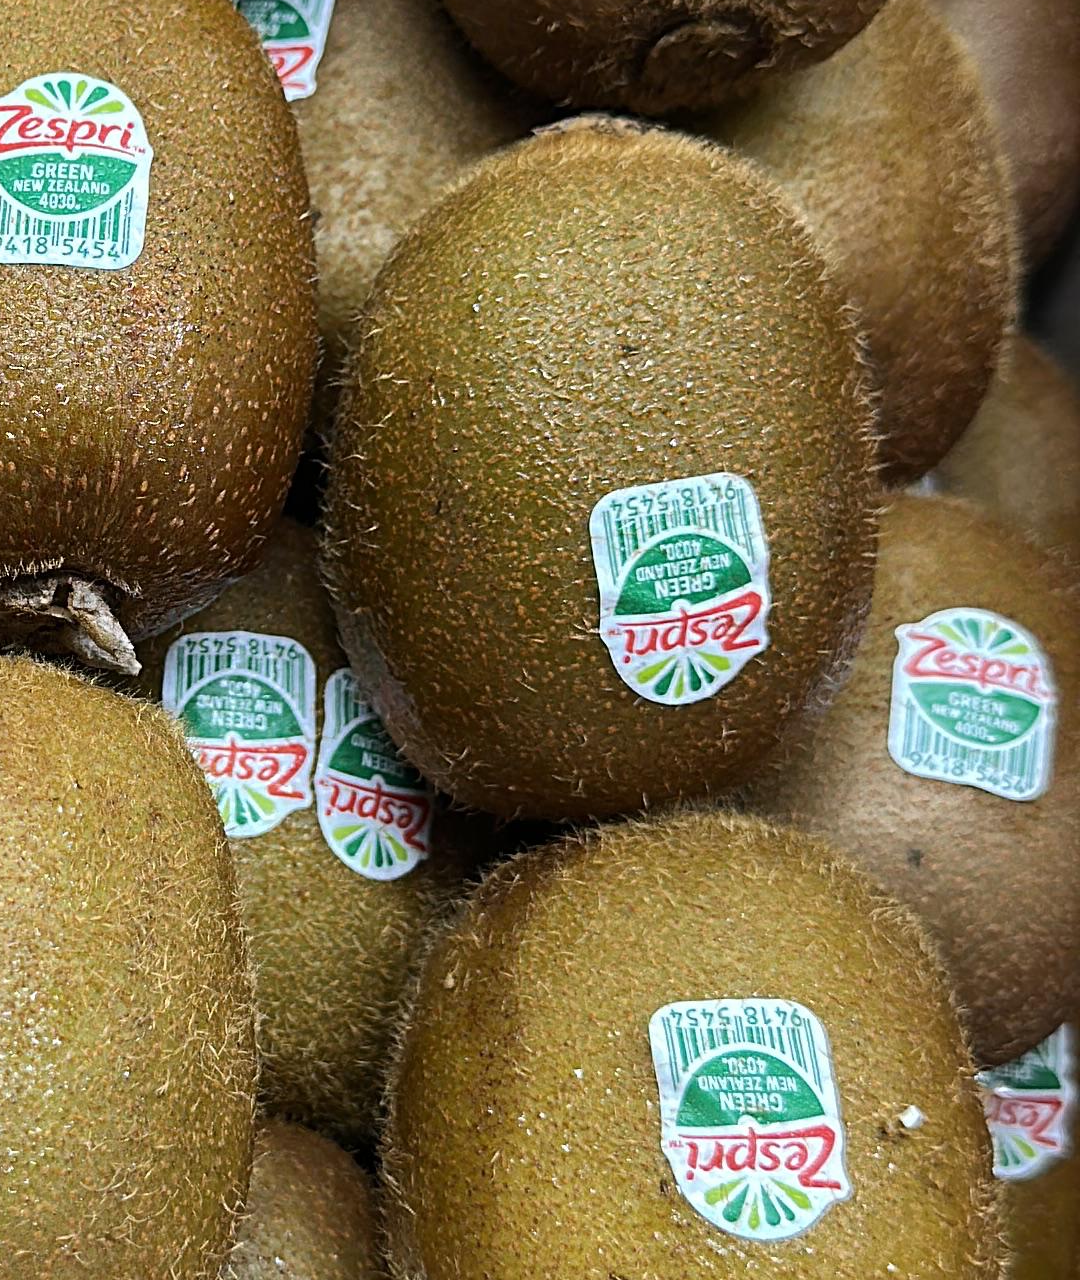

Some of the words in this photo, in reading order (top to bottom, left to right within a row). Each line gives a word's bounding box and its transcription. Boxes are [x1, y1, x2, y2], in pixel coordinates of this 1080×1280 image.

[31, 162, 93, 180] GREEN
[13, 179, 44, 193] NEW
[48, 180, 109, 195] ZEALAND
[62, 238, 120, 261] 5454
[610, 492, 668, 518] 5454
[680, 480, 736, 508] 9418
[636, 561, 702, 582] ZEALAND
[700, 552, 731, 570] NEW
[655, 572, 716, 599] GREEN
[617, 591, 762, 664] Zespri
[186, 636, 236, 654] 5454
[249, 638, 298, 660] 9418
[903, 631, 1041, 697] Zespri
[325, 778, 430, 852] Zespri
[670, 1006, 731, 1027] 5454
[743, 1005, 802, 1027] 9418
[699, 1075, 765, 1092] ZEALAND
[766, 1076, 798, 1093] NEW
[718, 1091, 784, 1113] GREEN
[678, 1124, 841, 1190] Zespri
